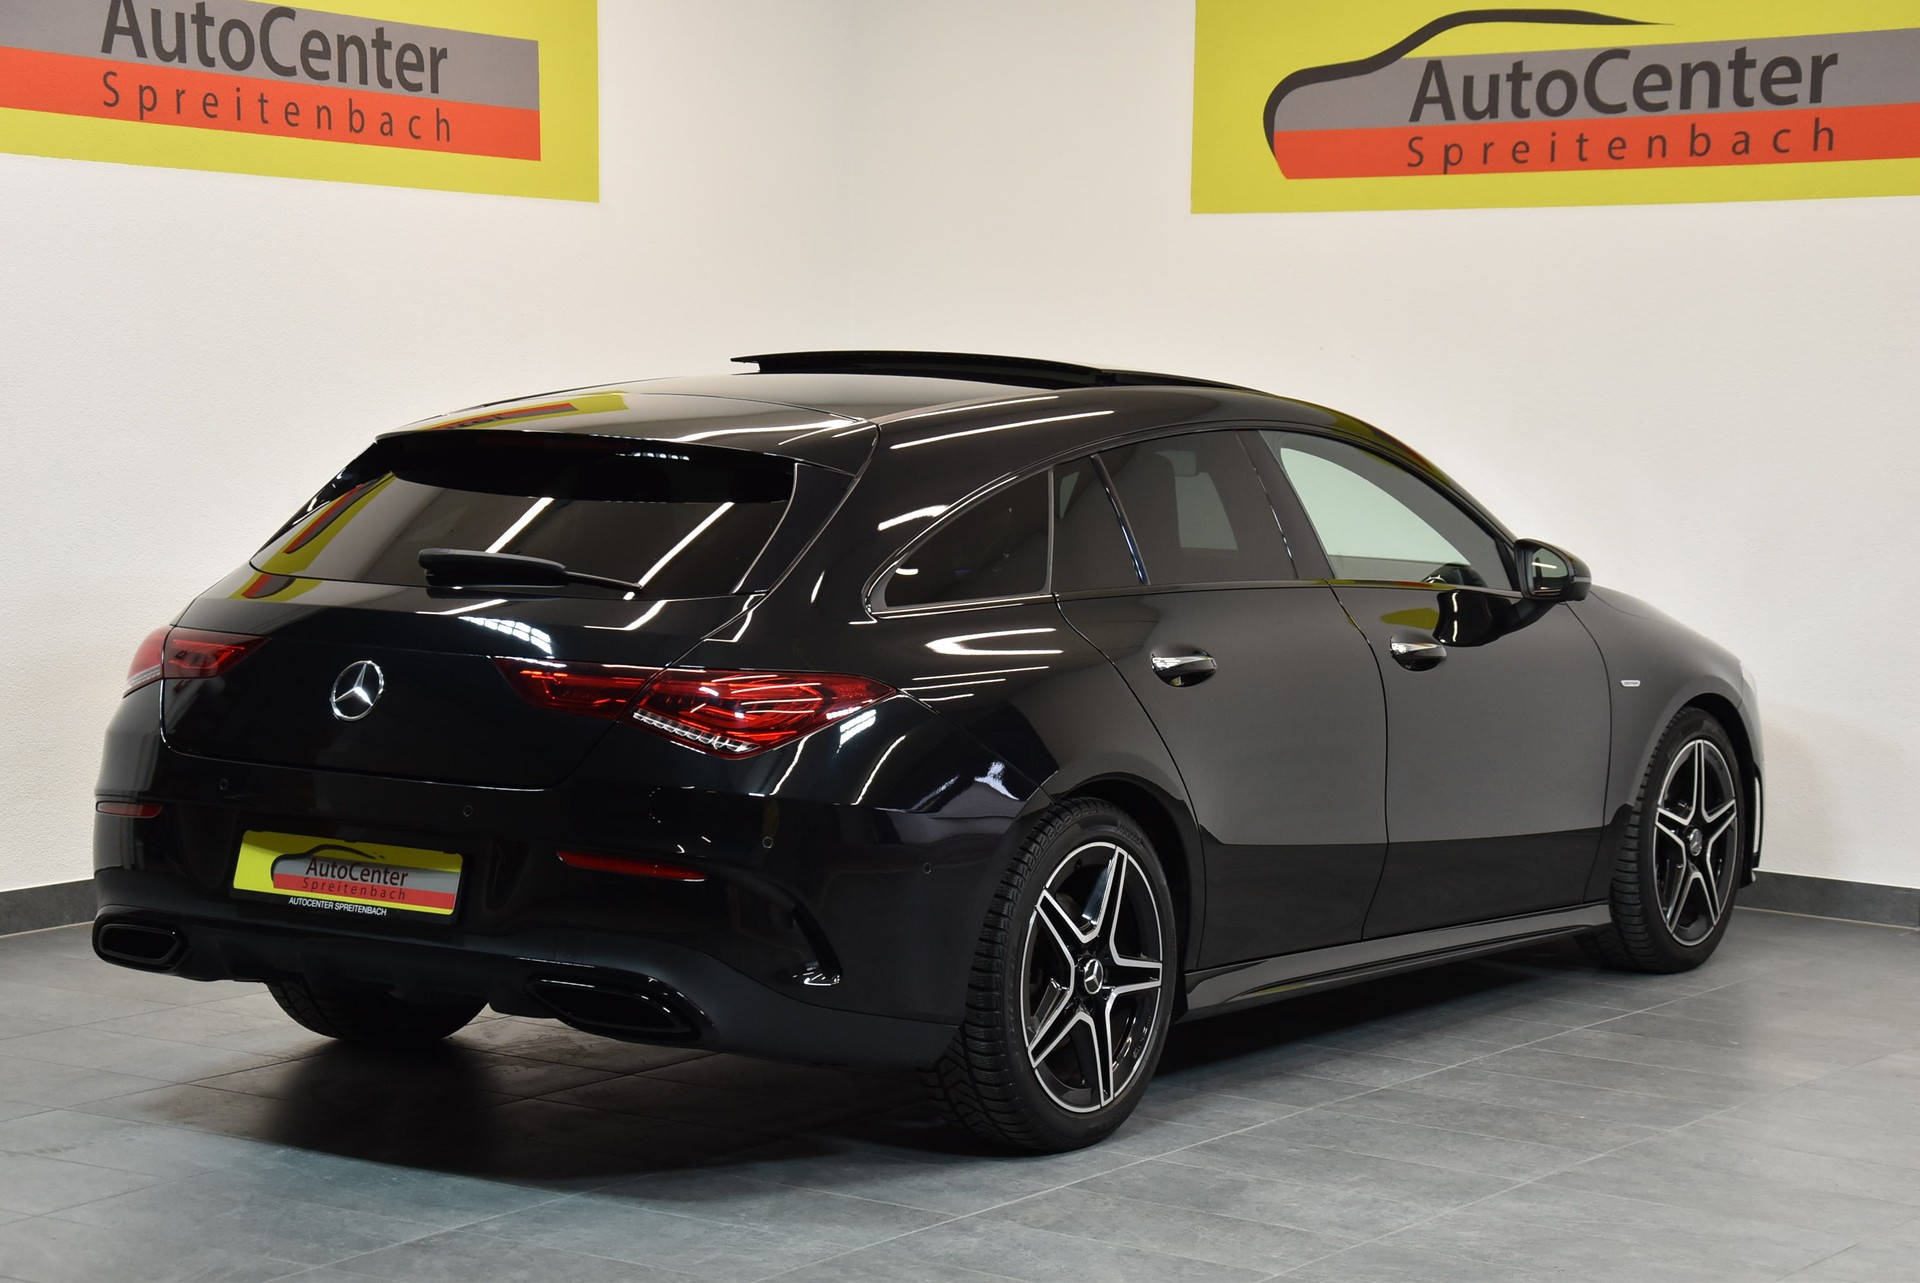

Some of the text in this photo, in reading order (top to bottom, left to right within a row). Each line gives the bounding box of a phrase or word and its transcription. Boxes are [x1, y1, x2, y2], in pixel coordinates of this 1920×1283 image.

[101, 0, 448, 94] AutoCenter
[102, 71, 451, 142] Spreitenbach
[1408, 47, 1839, 123] AutoCenter
[1406, 118, 1835, 175] Spreitenbach
[302, 877, 405, 900] Spreitenbach
[305, 857, 408, 887] AutoCenter
[288, 897, 388, 916] AUTOCENTER SPREITENBACH
